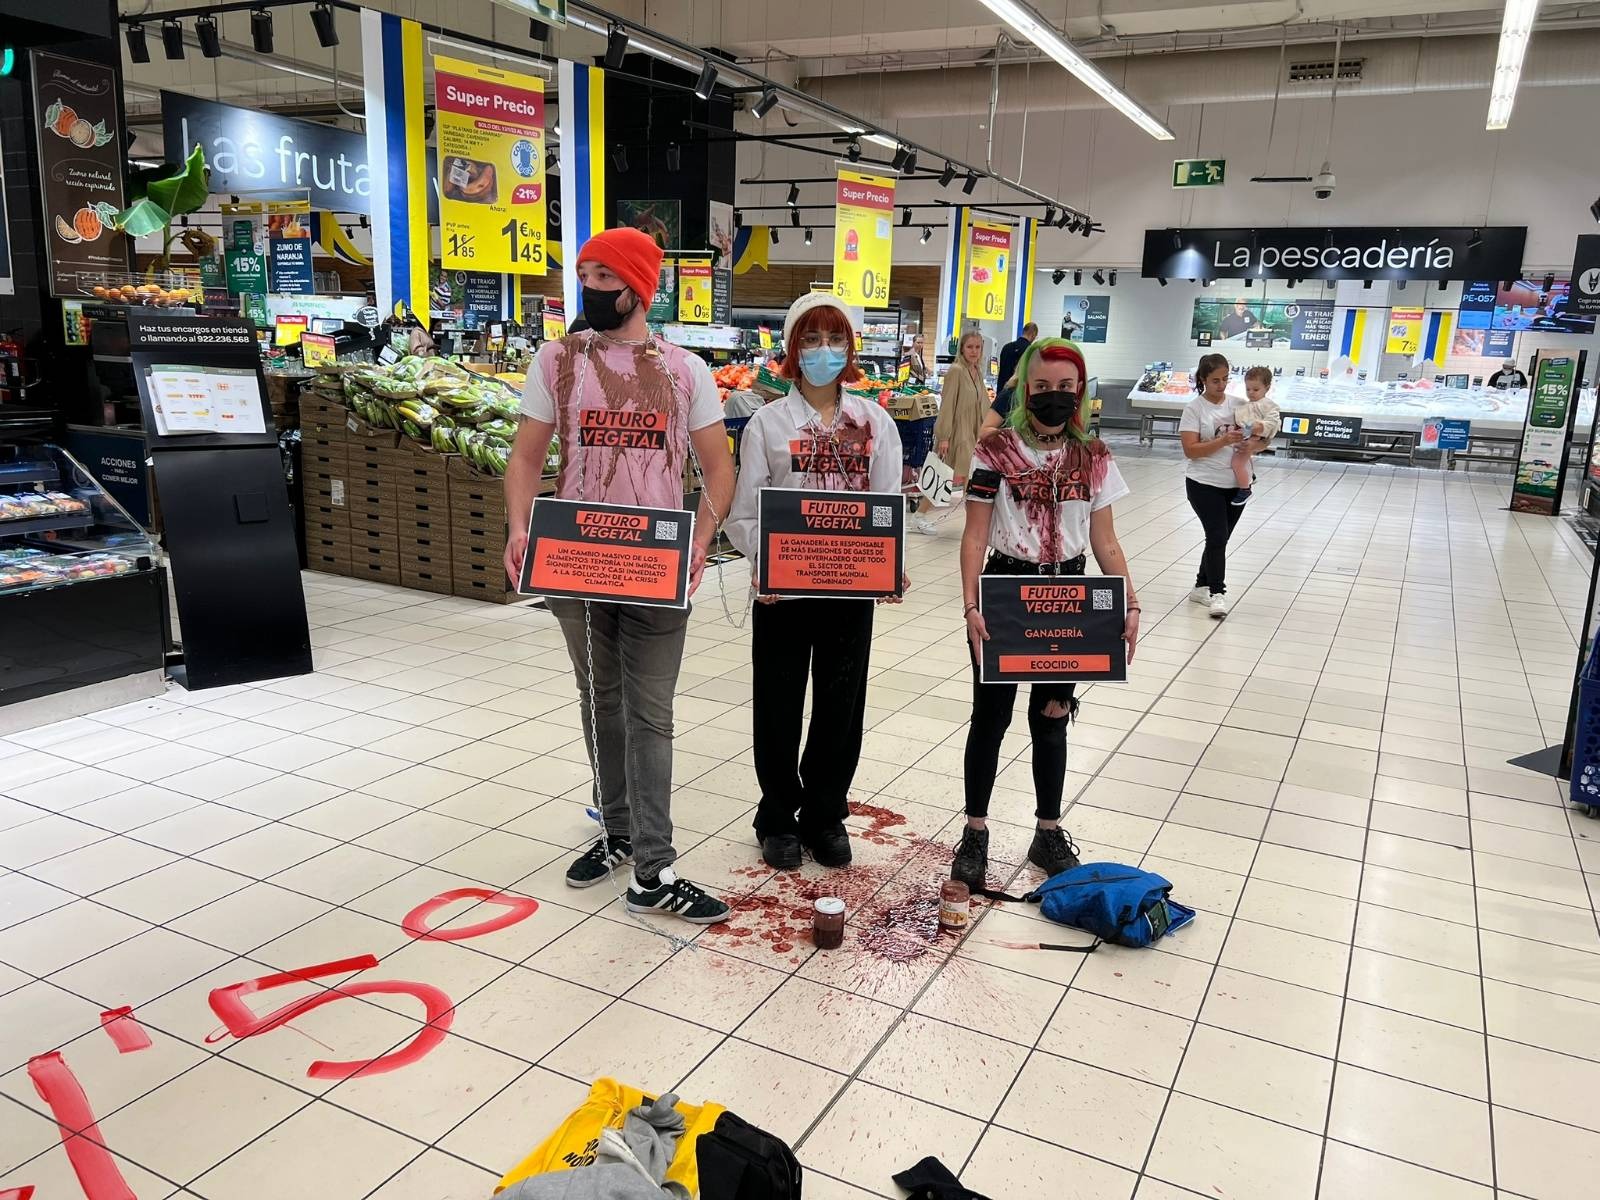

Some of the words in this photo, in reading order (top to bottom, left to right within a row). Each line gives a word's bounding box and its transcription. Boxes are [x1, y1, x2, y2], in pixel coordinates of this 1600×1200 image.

[447, 86, 490, 107] Super
[493, 95, 536, 116] Precio
[181, 117, 267, 187] Las
[273, 134, 377, 198] fruta
[515, 188, 538, 200] -21%
[842, 188, 865, 201] Super
[866, 192, 890, 204] Precio
[502, 218, 519, 263] 1
[520, 243, 542, 263] 45
[975, 232, 991, 241] Super
[991, 235, 1007, 244] Precio
[276, 243, 294, 251] ZUMO
[294, 243, 303, 251] DE
[276, 253, 303, 261] NARANJA
[1213, 240, 1250, 268] La
[1258, 238, 1455, 275] pescadería
[230, 257, 261, 273] -15%
[1462, 294, 1496, 303] PE-057
[469, 303, 498, 312] TENERIFE
[139, 324, 156, 333] Haz
[172, 327, 210, 335] encargos
[222, 326, 249, 334] tienda
[148, 335, 187, 343] llamando
[188, 335, 196, 343] al
[197, 335, 250, 344] 922.236.568
[1537, 384, 1568, 397] -15%
[585, 410, 658, 429] FUTURO
[1315, 418, 1343, 426] Pescado
[582, 429, 660, 449] VEGETAL
[1323, 431, 1351, 440] Canarias
[101, 457, 137, 469] ACCIONES
[1018, 485, 1088, 501] VEGTAL
[807, 502, 859, 515] FUTURO
[584, 513, 641, 528] FUTURO
[804, 516, 863, 530] VEGETAL
[580, 526, 643, 542] VEGETAL
[790, 538, 830, 547] GANADERÍA
[840, 541, 885, 549] RESPONSABLE
[557, 547, 570, 555] UN
[570, 548, 601, 558] CAMBIO
[601, 551, 631, 560] MASIVO
[643, 555, 659, 563] LOS
[807, 547, 843, 555] EMISIONES
[546, 552, 589, 564] ALIMENTOS
[590, 556, 622, 567] TENDRÍA
[623, 560, 635, 568] UN
[635, 561, 668, 571] IMPACTO
[804, 555, 851, 563] INVERNADERO
[545, 559, 600, 572] SIGNIFICATIVO
[607, 565, 625, 574] CASI
[626, 567, 666, 577] INMEDIATO
[796, 570, 839, 578] TRANSPORTE
[571, 569, 611, 579] SOLUCIÓN
[634, 576, 659, 584] CRISIS
[811, 577, 853, 585] COMBINADO
[1027, 587, 1079, 599] FUTURO
[1025, 601, 1083, 613] VEGETAL
[1024, 626, 1084, 638] GANADERÍA
[1030, 660, 1079, 670] ECOCIDIO
